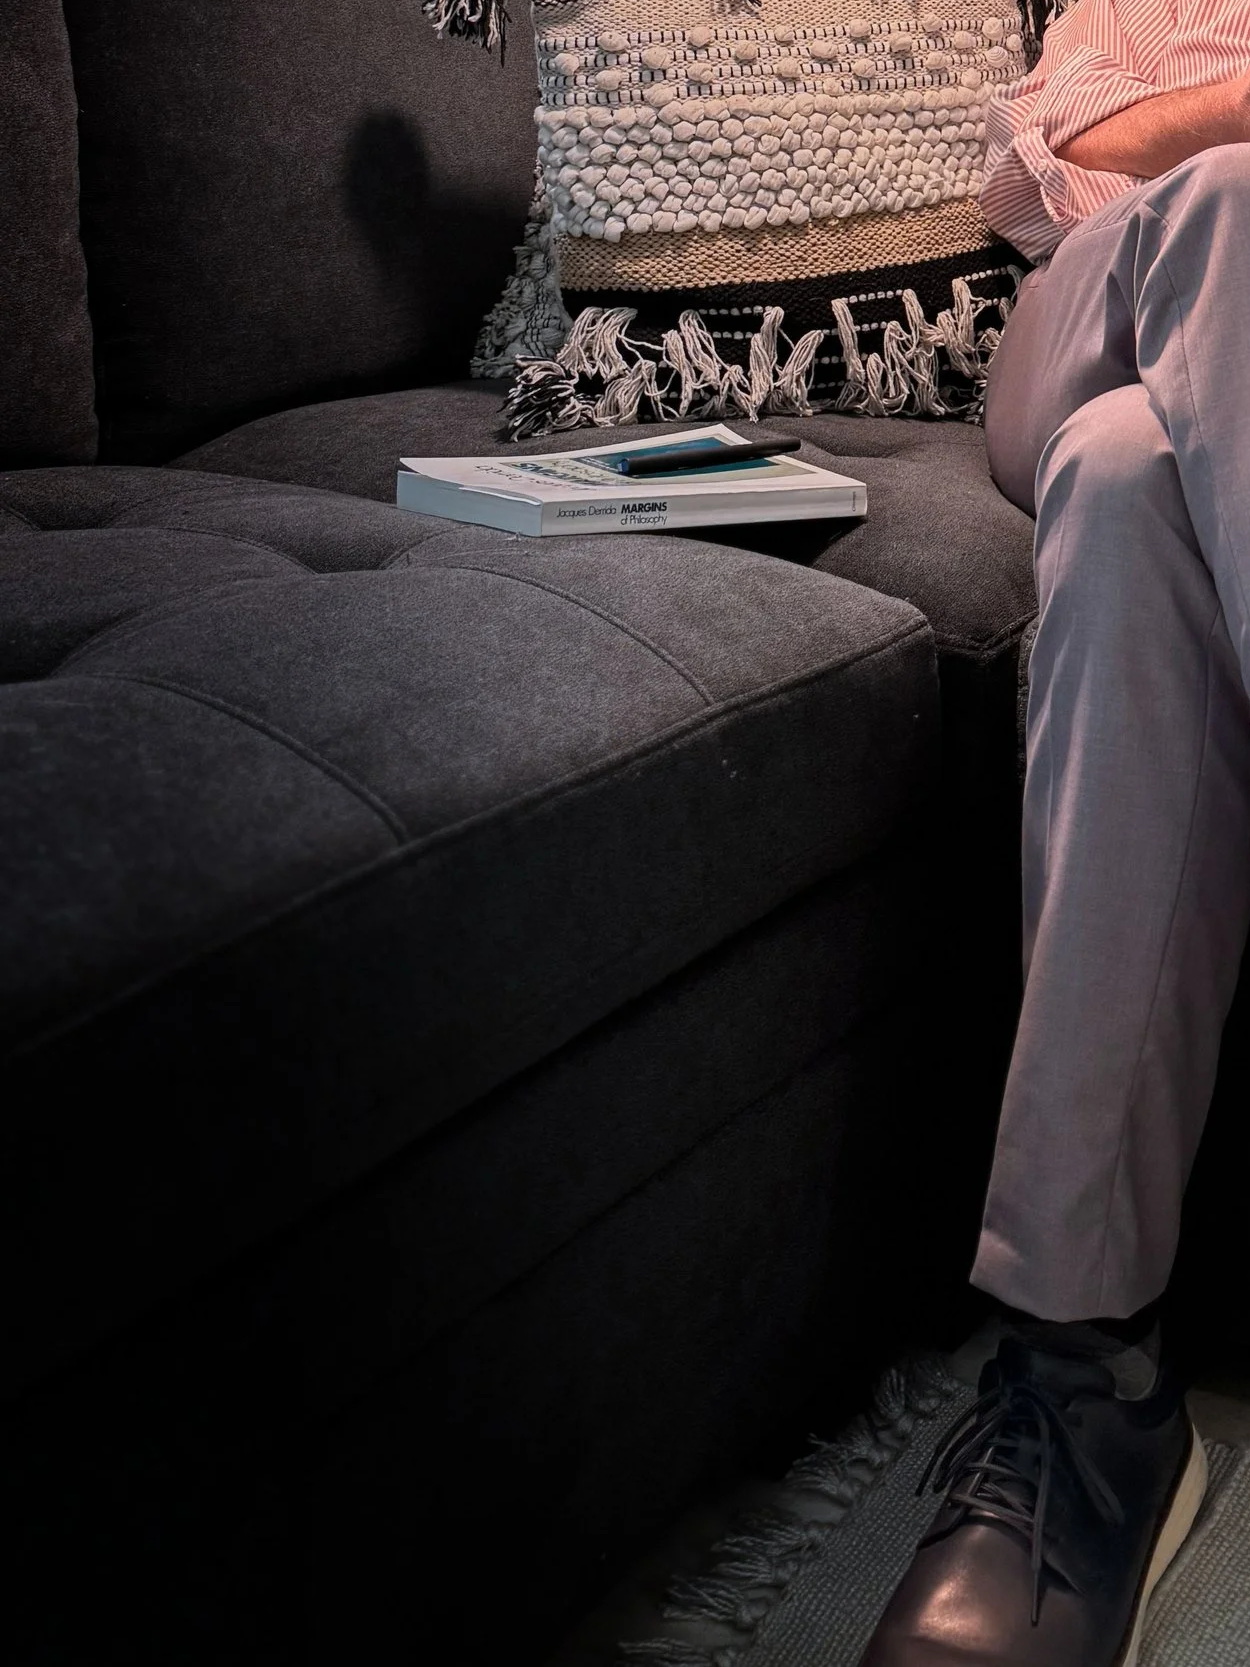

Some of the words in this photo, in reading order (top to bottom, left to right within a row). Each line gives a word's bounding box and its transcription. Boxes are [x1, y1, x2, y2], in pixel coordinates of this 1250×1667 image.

[556, 507, 586, 519] Jacques
[621, 501, 668, 514] MARGINS
[620, 515, 629, 526] of
[629, 513, 668, 526] Philosophy
